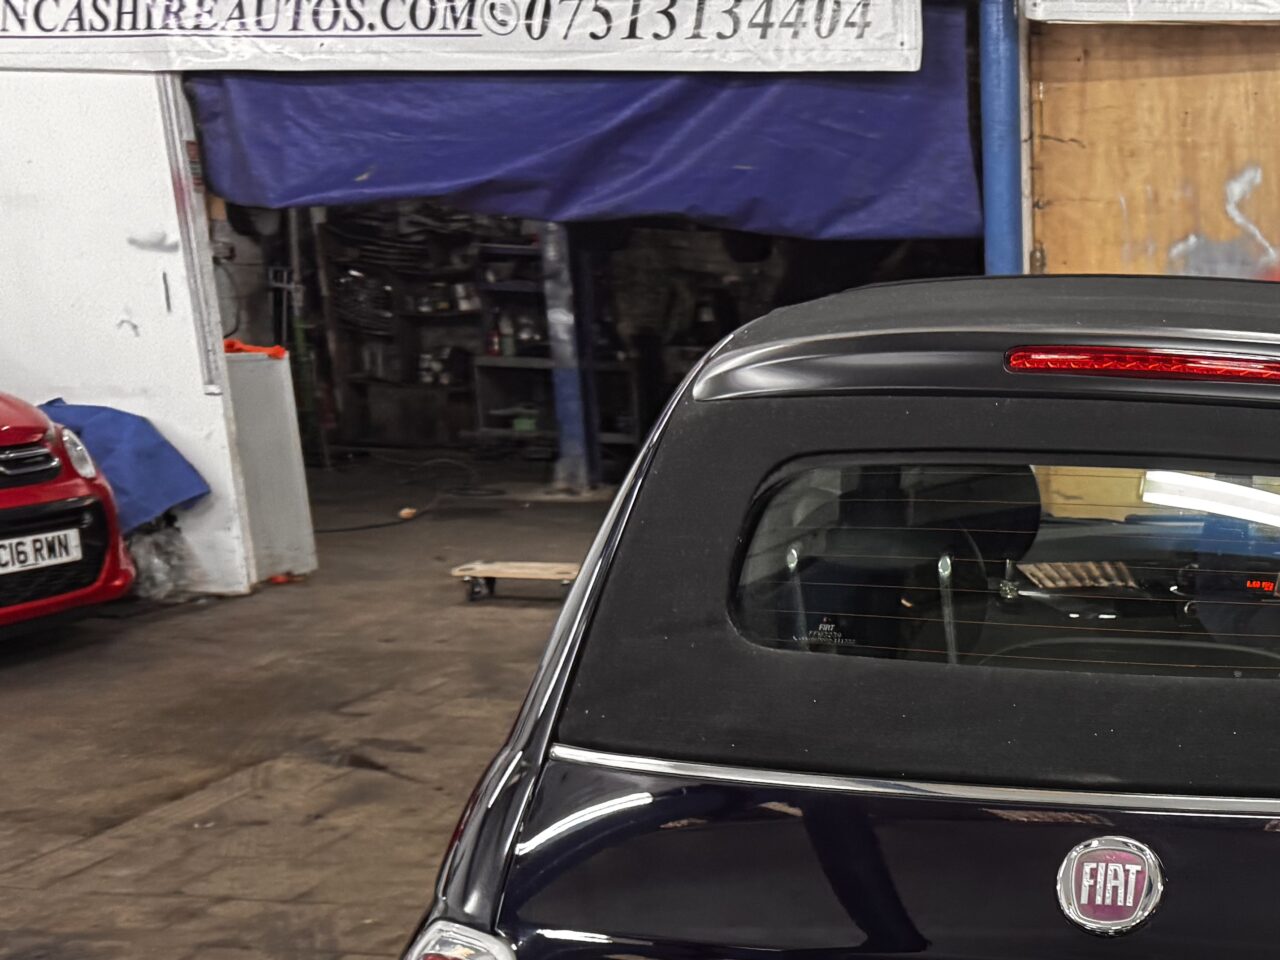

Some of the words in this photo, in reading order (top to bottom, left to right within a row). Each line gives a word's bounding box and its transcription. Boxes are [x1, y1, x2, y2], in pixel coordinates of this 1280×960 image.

[525, 0, 872, 41] 07513134404
[32, 533, 70, 563] RWN
[1080, 862, 1142, 907] FIAT
